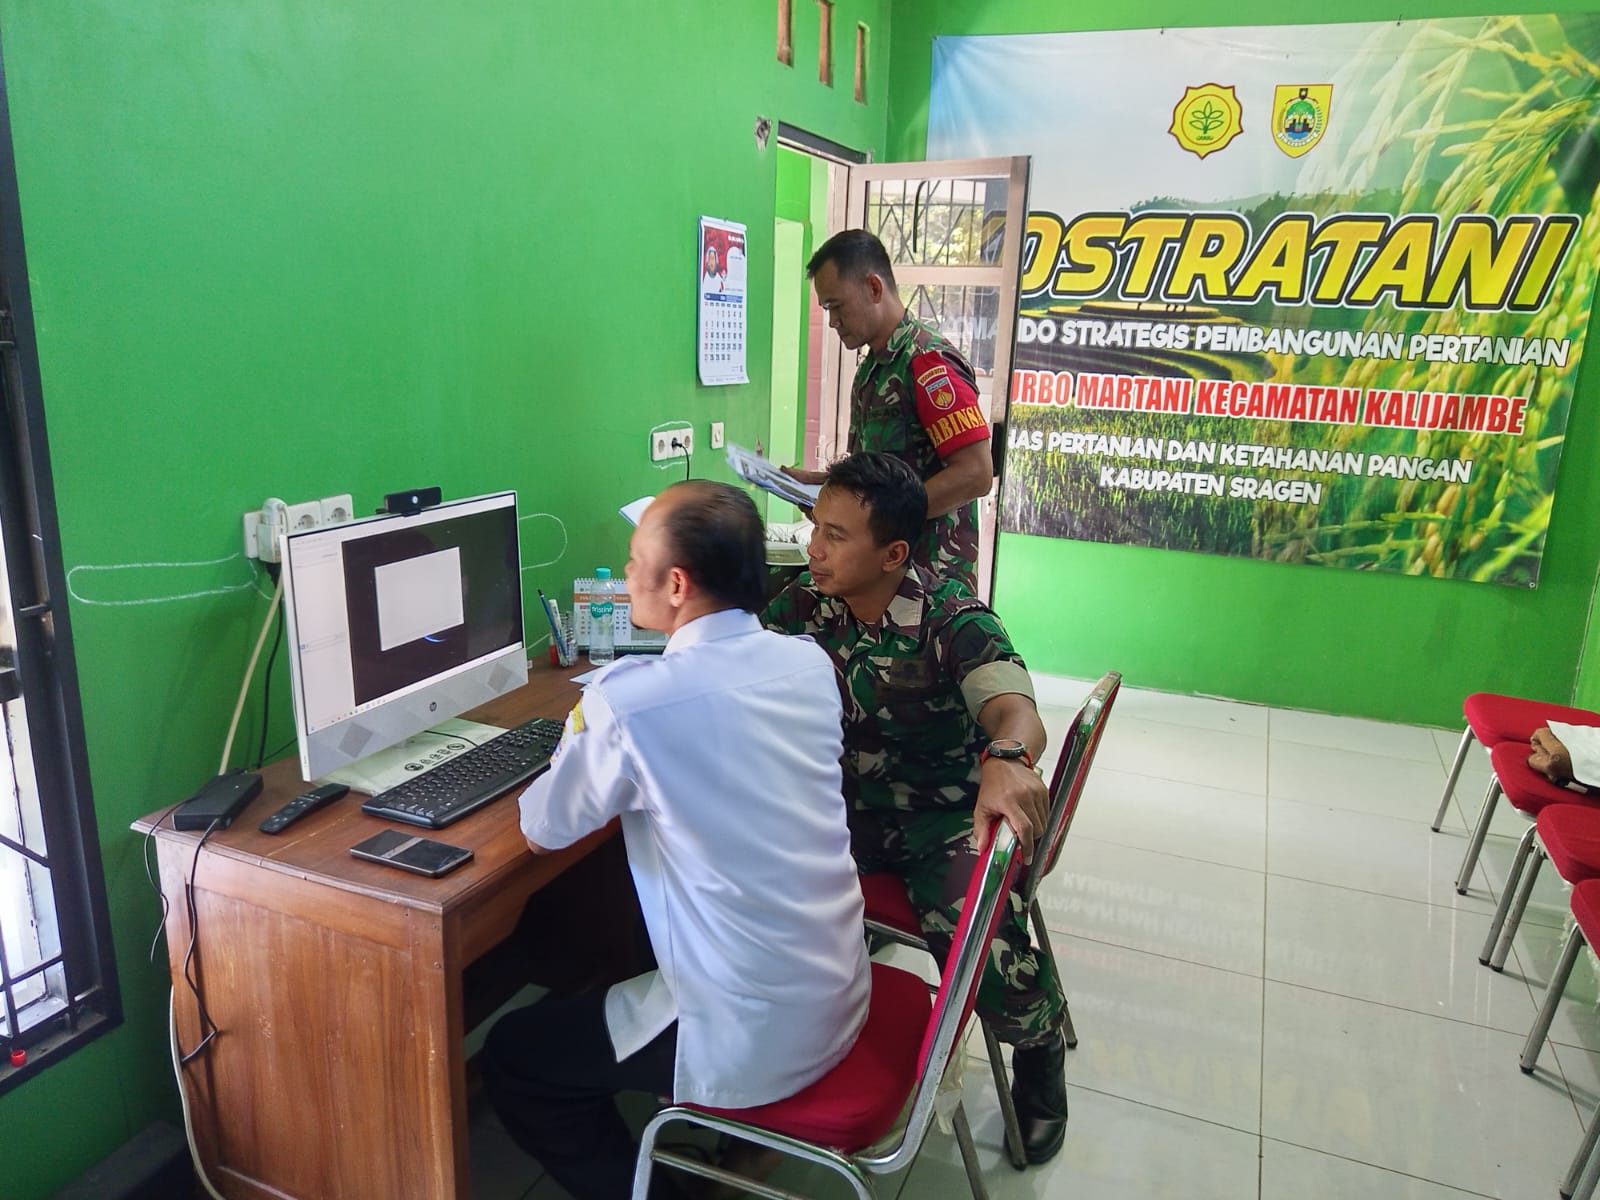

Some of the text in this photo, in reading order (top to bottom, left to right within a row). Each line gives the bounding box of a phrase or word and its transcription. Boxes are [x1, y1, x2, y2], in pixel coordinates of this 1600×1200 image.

[1020, 210, 1583, 313] OSTRATANI
[1061, 320, 1190, 349] STRATEGIS
[1194, 325, 1405, 360] PEMBANGUNAN
[1408, 334, 1570, 367] PERTANIAN
[1075, 372, 1193, 415] MARTANI
[1194, 379, 1362, 425] KECAMATAN
[1363, 389, 1528, 435] KALIJAMBE
[1047, 431, 1163, 460] PERTANIAN
[1167, 439, 1216, 463] DAN
[1219, 443, 1364, 476] KETAHANAN
[1367, 454, 1473, 484] PANGAN
[1100, 466, 1322, 506] KABUPATEN SRAGEN
